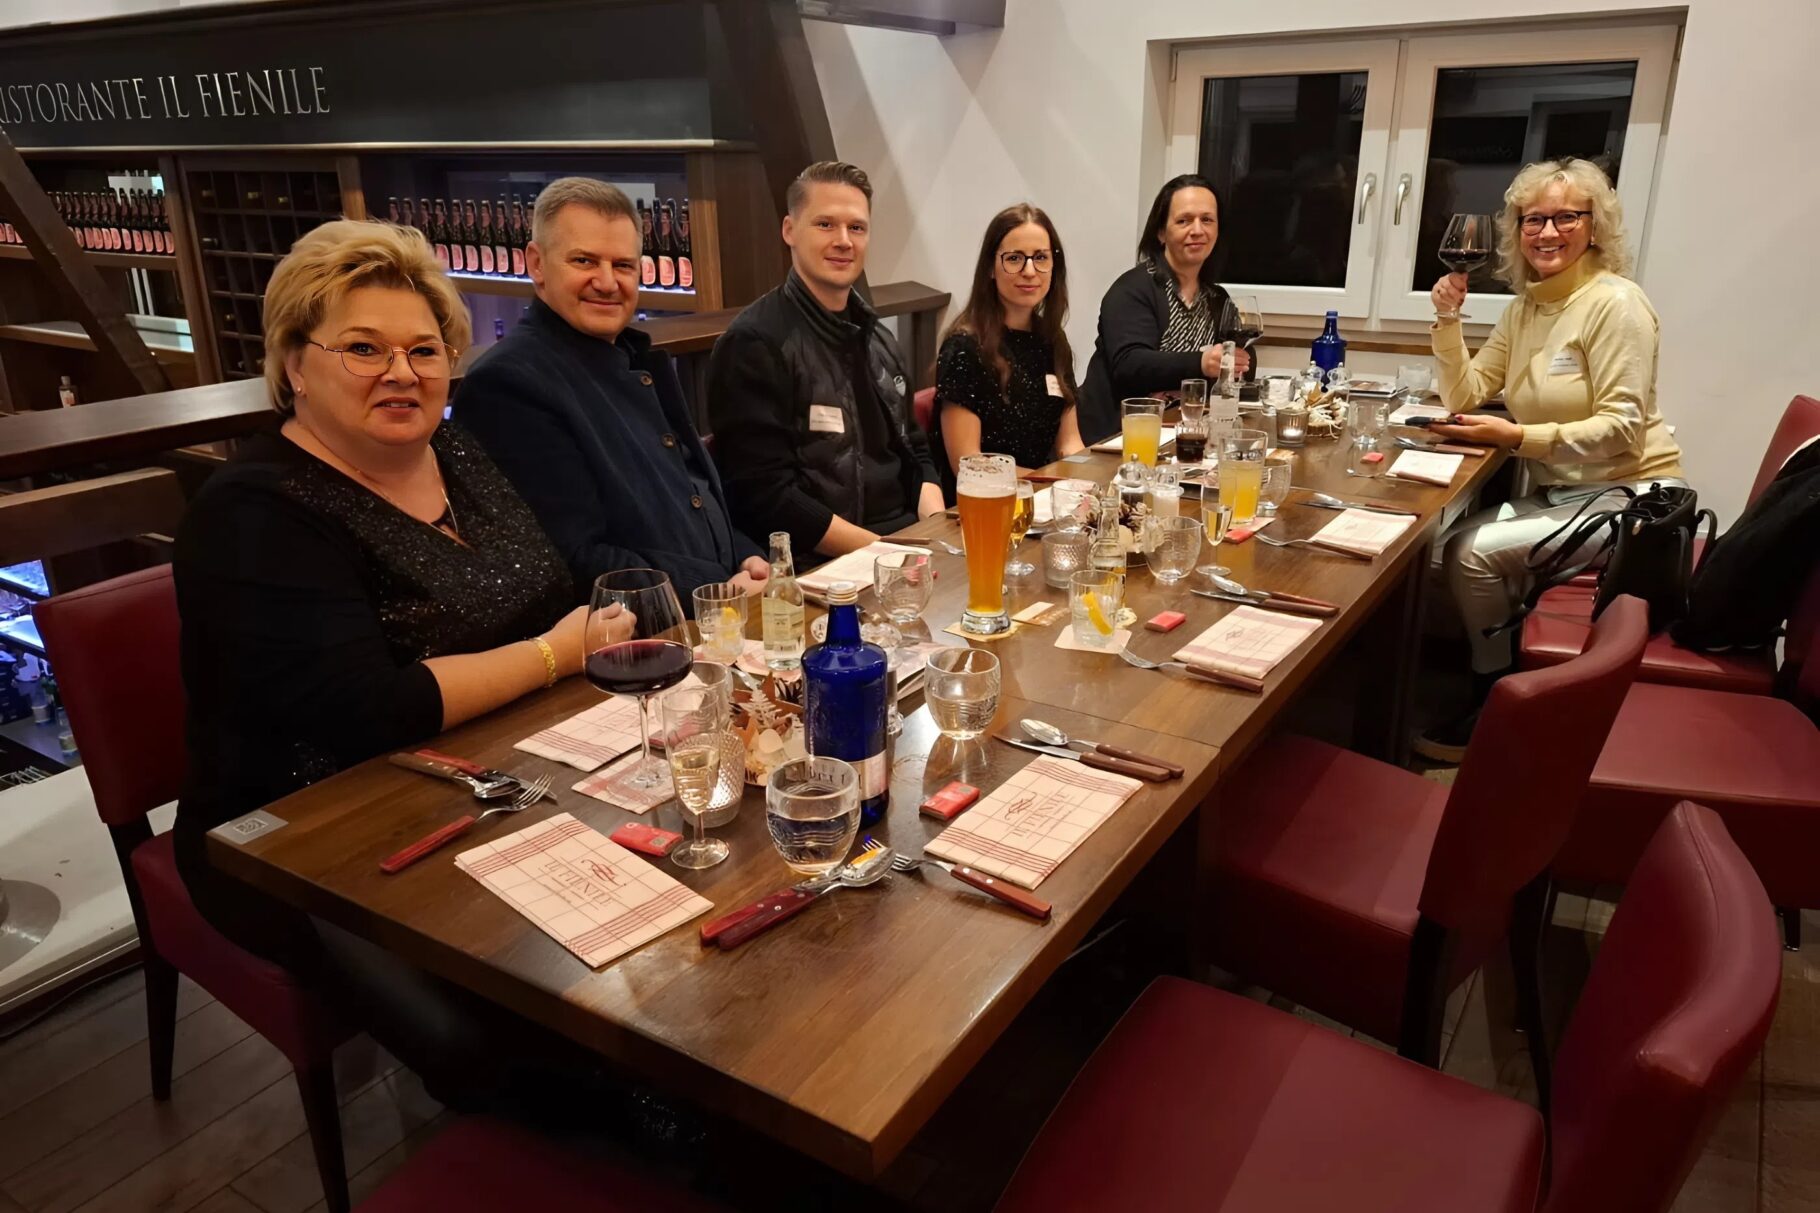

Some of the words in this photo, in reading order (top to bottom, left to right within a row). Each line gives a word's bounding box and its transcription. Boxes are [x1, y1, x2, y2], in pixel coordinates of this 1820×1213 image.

[0, 77, 152, 124] ISTORANTE
[157, 75, 190, 119] IL
[195, 66, 331, 118] FIENILE
